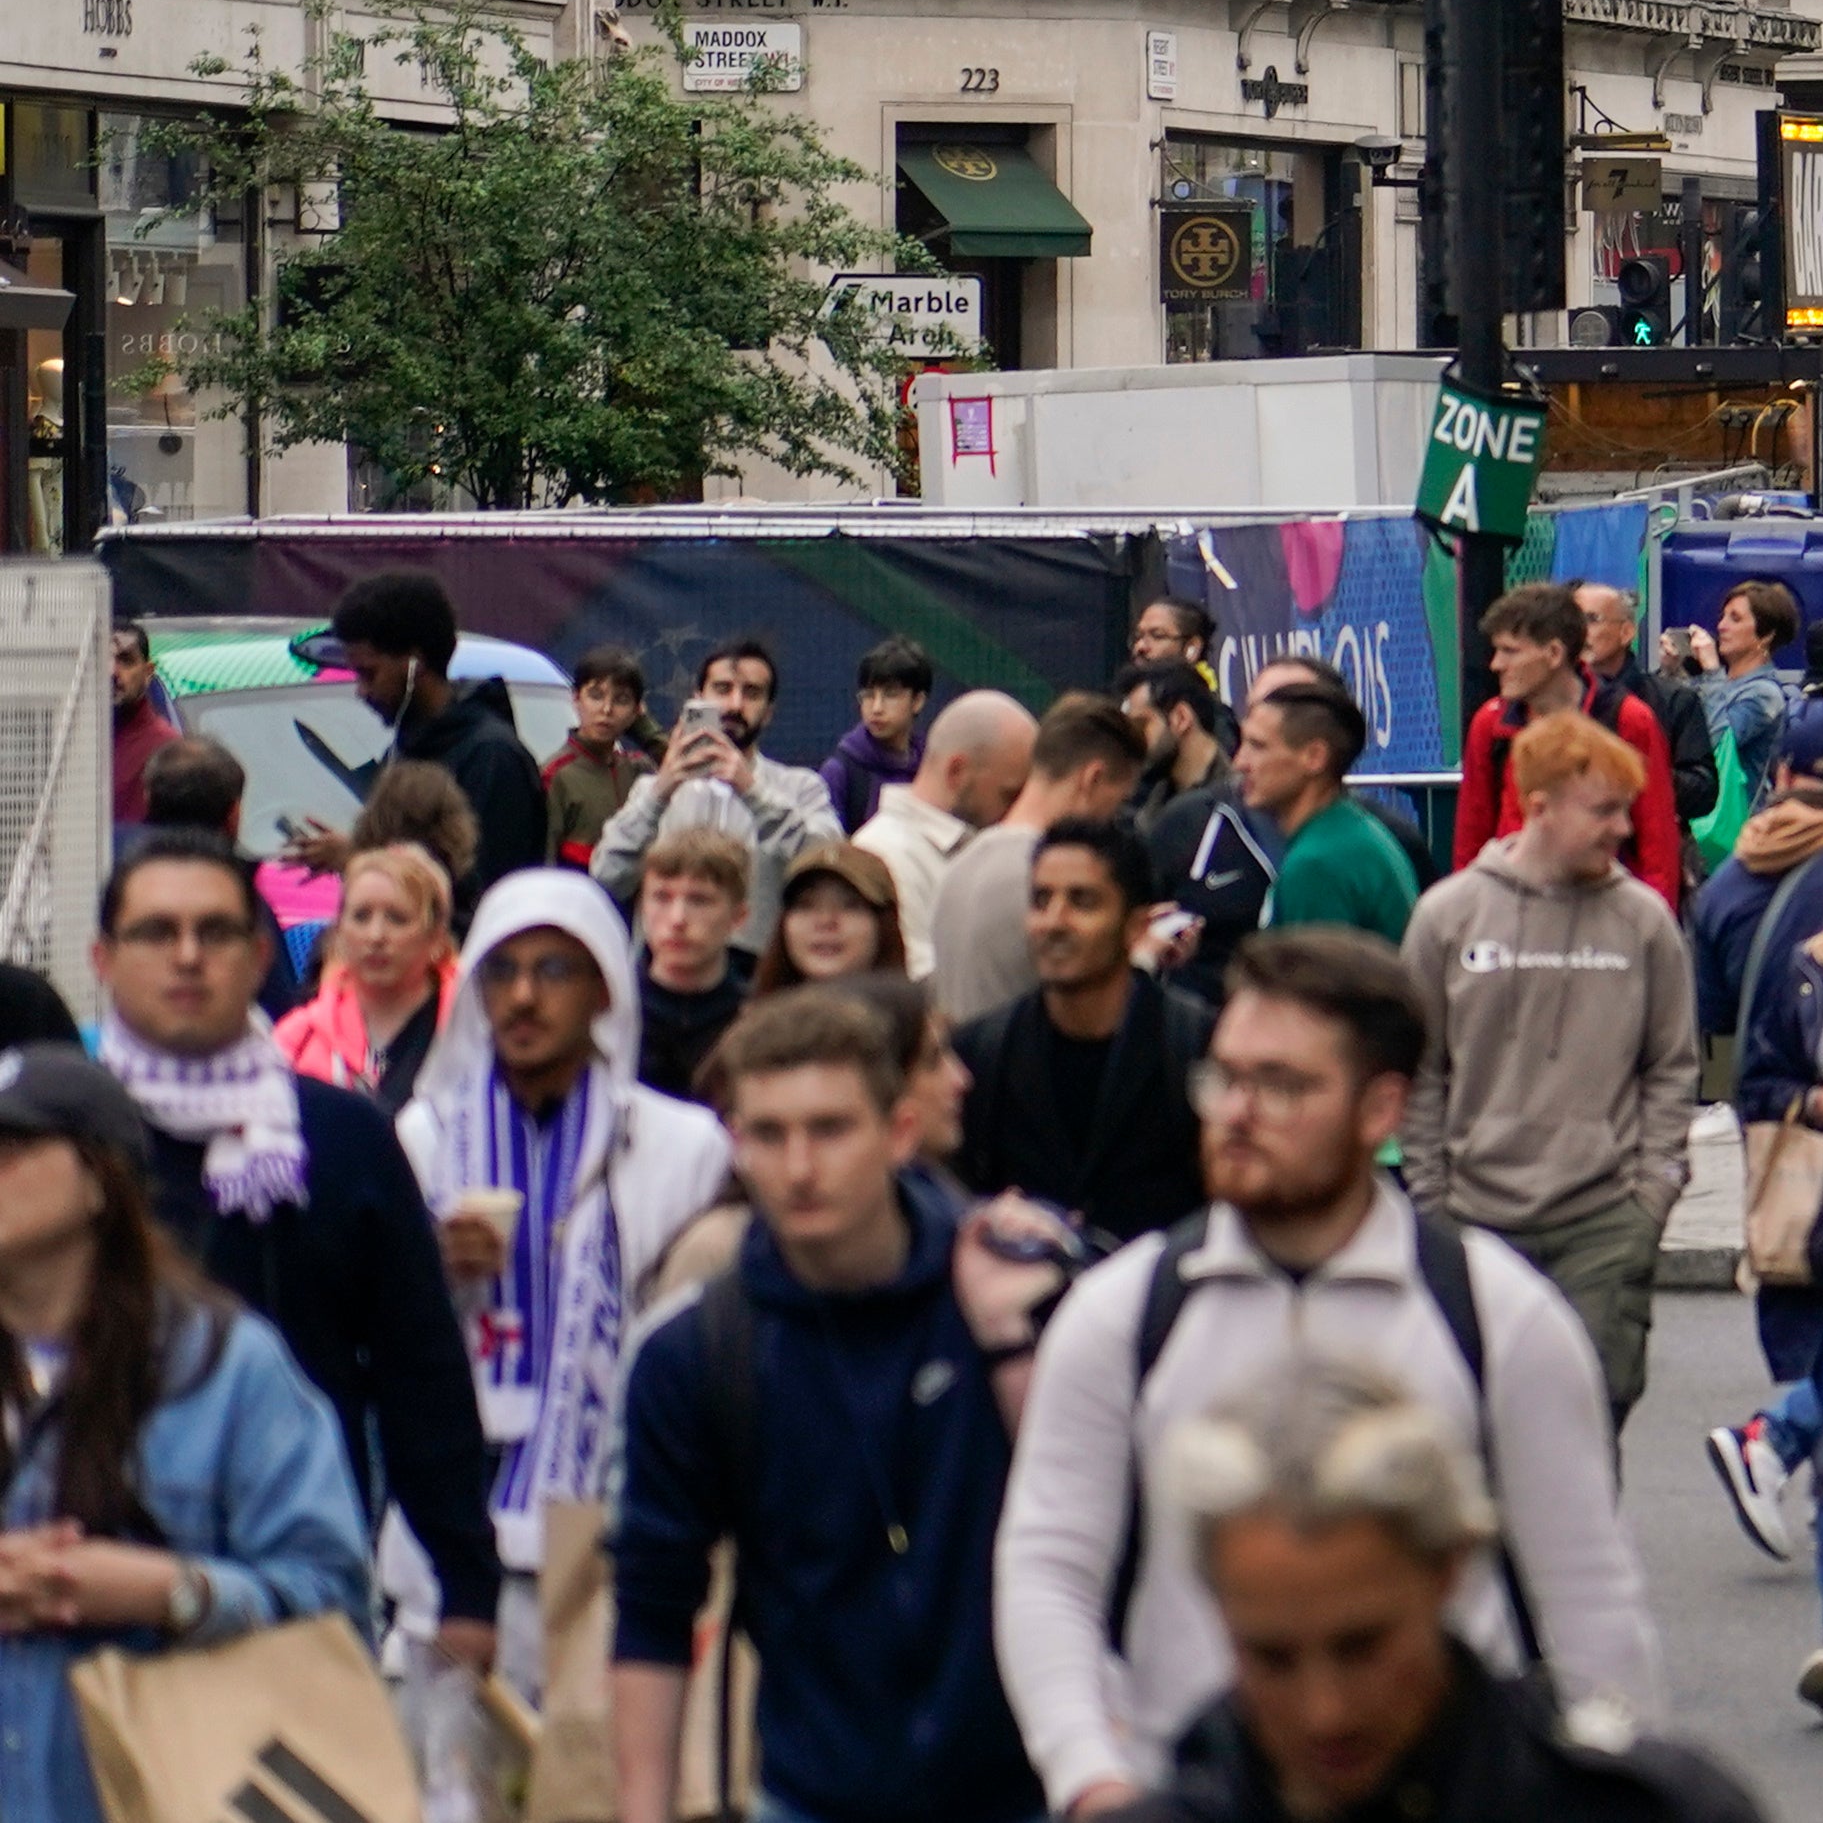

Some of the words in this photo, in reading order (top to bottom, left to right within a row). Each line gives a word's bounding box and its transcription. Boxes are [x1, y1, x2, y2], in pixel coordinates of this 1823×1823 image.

[695, 31, 768, 48] MADDOX
[960, 68, 1000, 93] 223
[870, 290, 970, 313] Marble
[1434, 392, 1541, 464] ZONE
[1440, 462, 1480, 533] A
